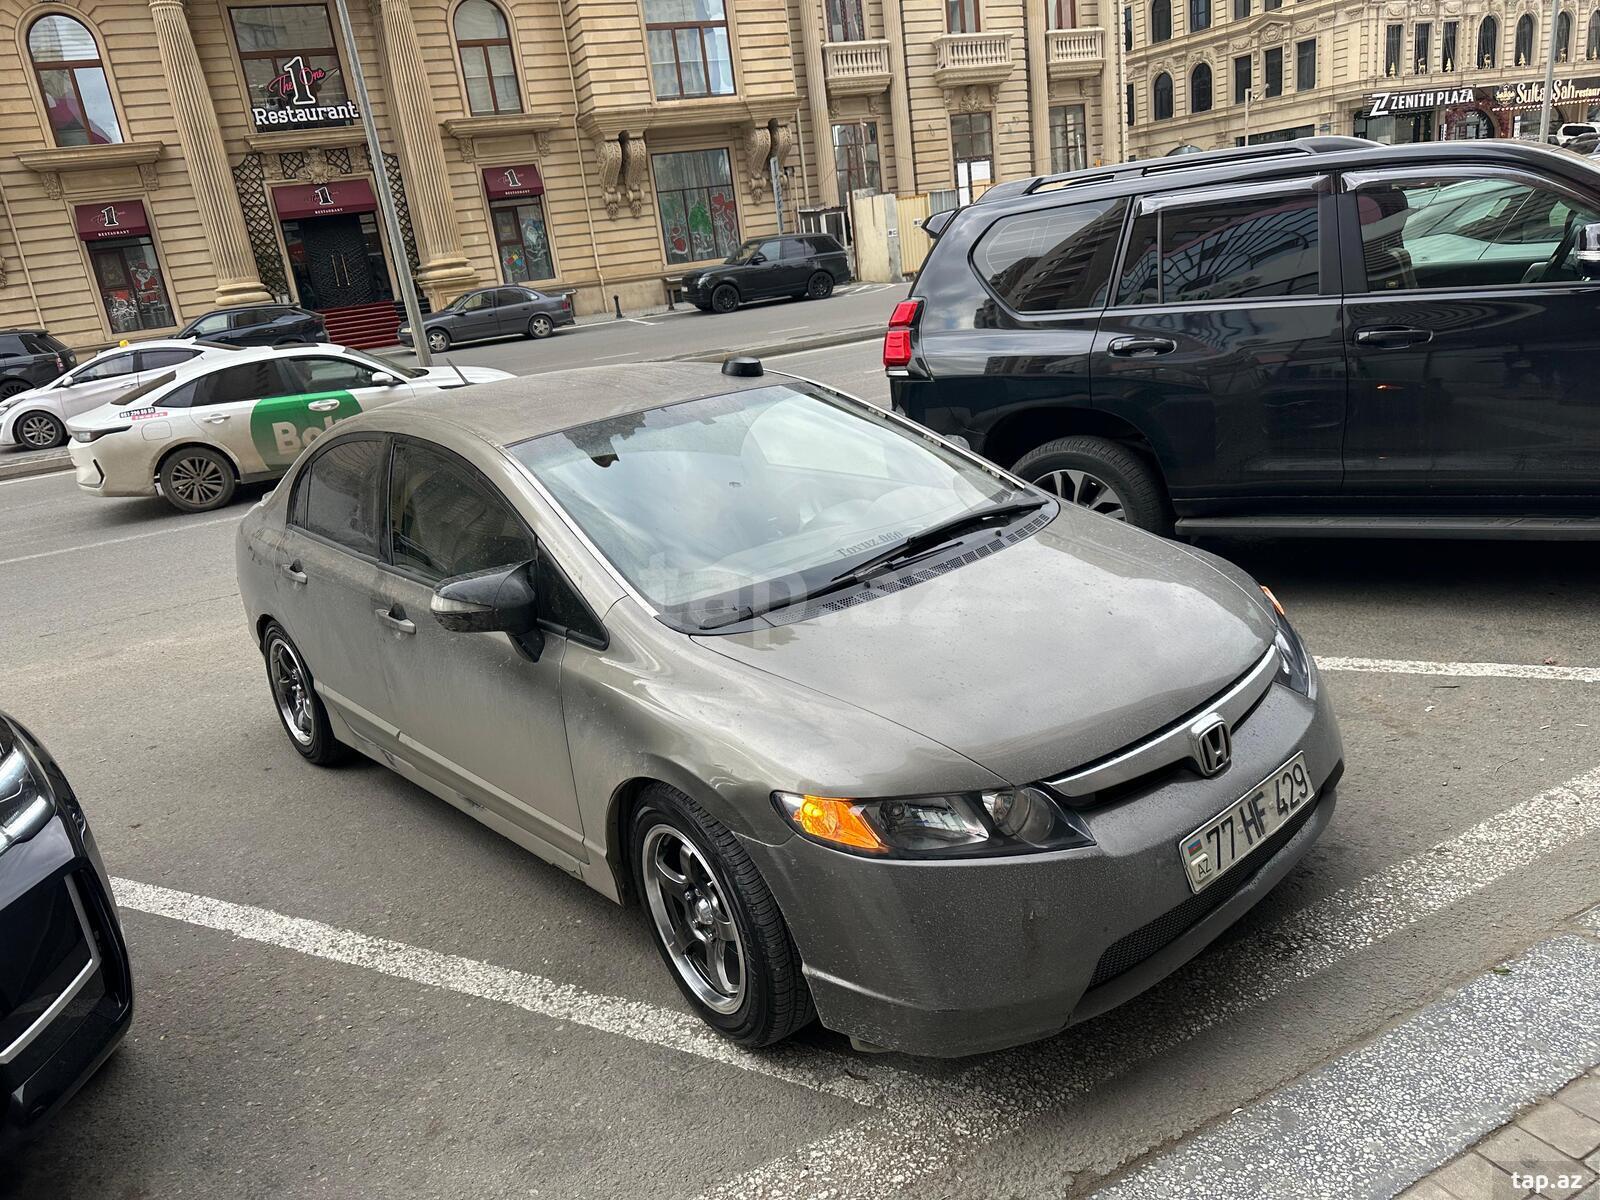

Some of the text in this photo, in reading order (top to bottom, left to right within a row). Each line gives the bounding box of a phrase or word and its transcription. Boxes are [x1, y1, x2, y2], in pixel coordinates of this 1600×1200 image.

[268, 56, 325, 105] The 1 One
[1516, 82, 1554, 104] Sulta
[1553, 79, 1575, 102] Şah
[1390, 92, 1434, 110] ZENITH
[1436, 88, 1475, 106] PLAZA
[252, 101, 359, 125] Restaurant
[271, 415, 343, 454] Bo
[1206, 763, 1308, 870] 77 HF 429
[1197, 858, 1212, 878] AZ
